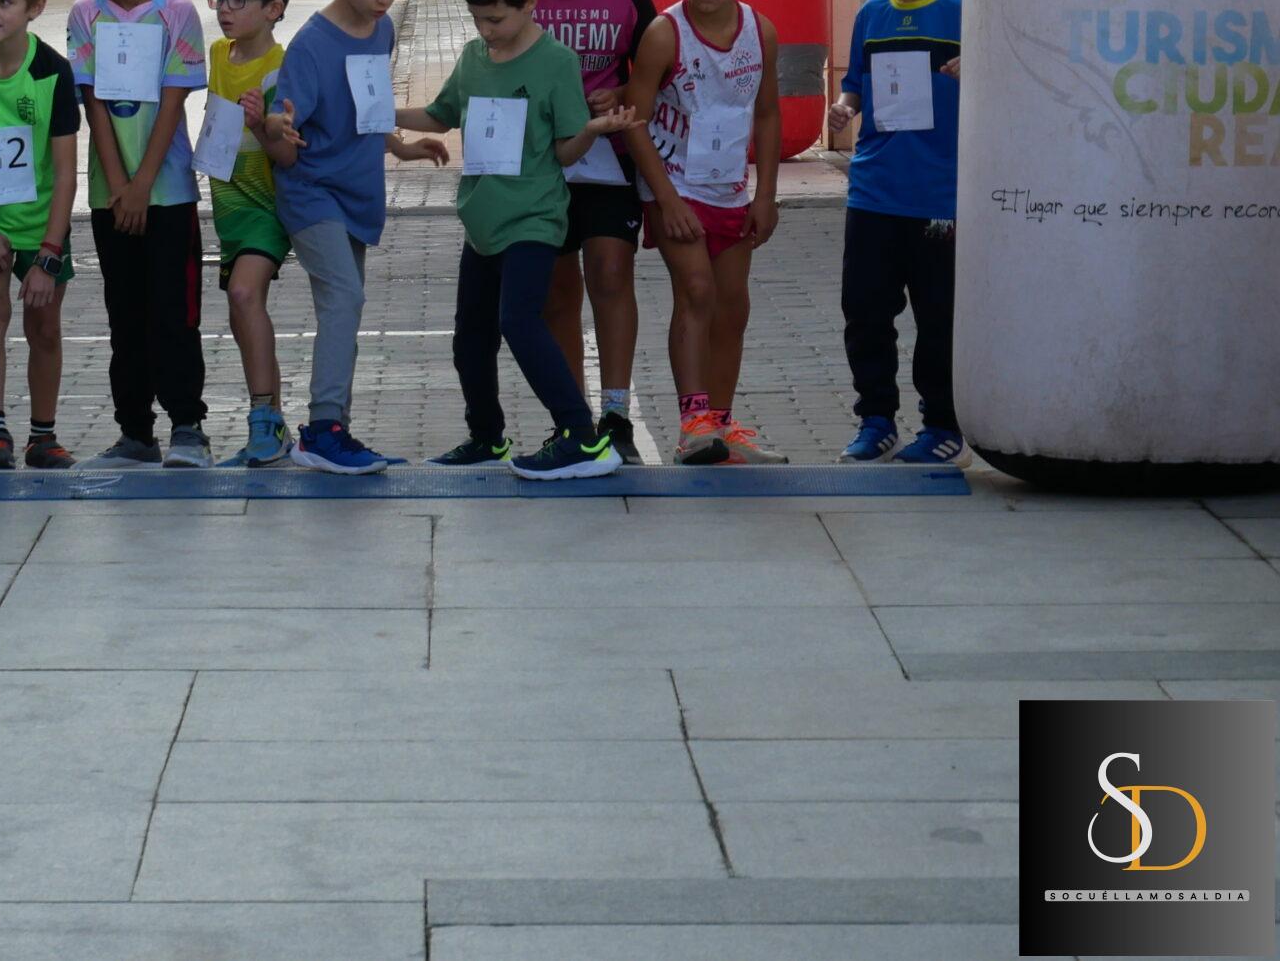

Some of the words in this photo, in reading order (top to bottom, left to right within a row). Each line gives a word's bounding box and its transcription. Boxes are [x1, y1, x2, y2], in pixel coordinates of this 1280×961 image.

[532, 8, 610, 21] ATLETISMO
[7, 137, 28, 169] 2
[1025, 189, 1063, 223] lugar
[1073, 200, 1109, 226] que
[1120, 197, 1213, 226] siempre
